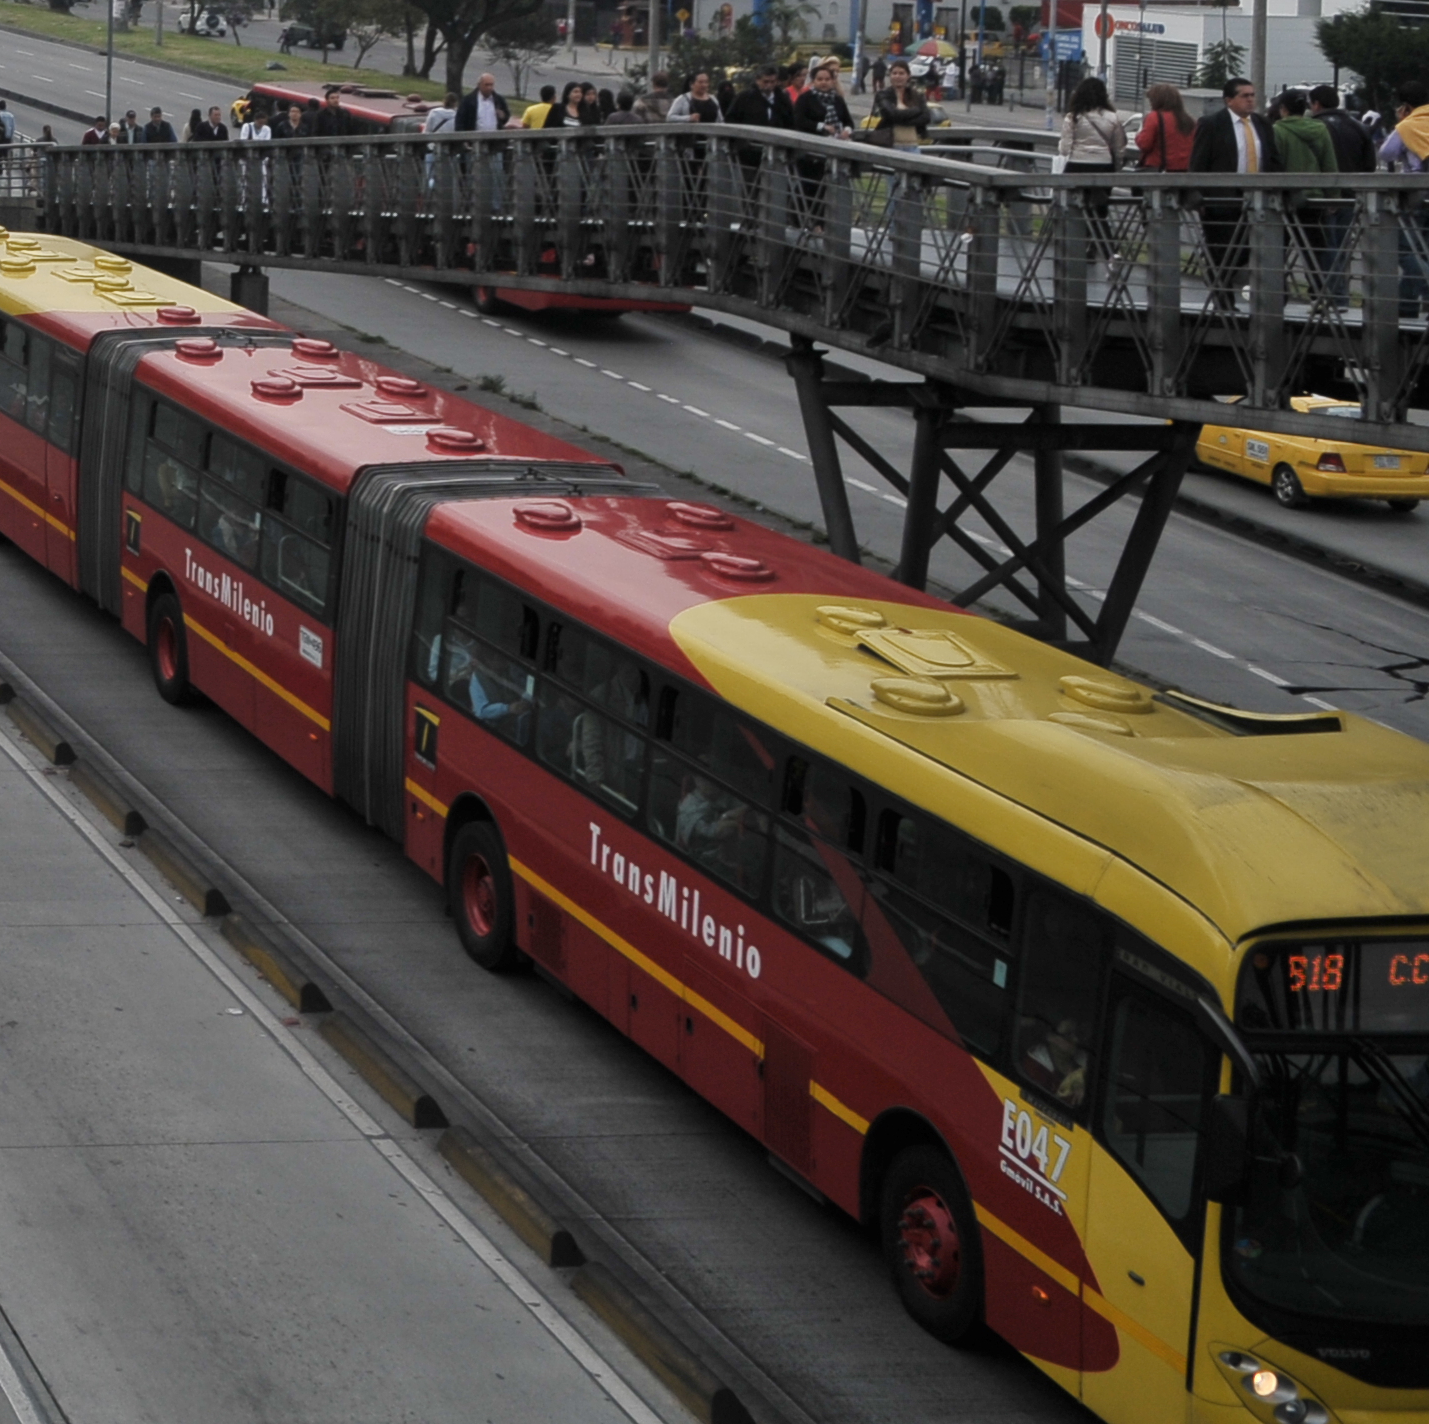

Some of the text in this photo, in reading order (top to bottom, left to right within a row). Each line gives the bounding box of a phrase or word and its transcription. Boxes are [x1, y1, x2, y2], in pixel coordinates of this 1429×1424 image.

[185, 547, 274, 637] TransMilenio
[589, 821, 762, 979] TransMilenio
[1001, 1097, 1072, 1184] E047
[1034, 1185, 1063, 1216] S.A.S.
[1315, 1347, 1371, 1359] VOLVO
